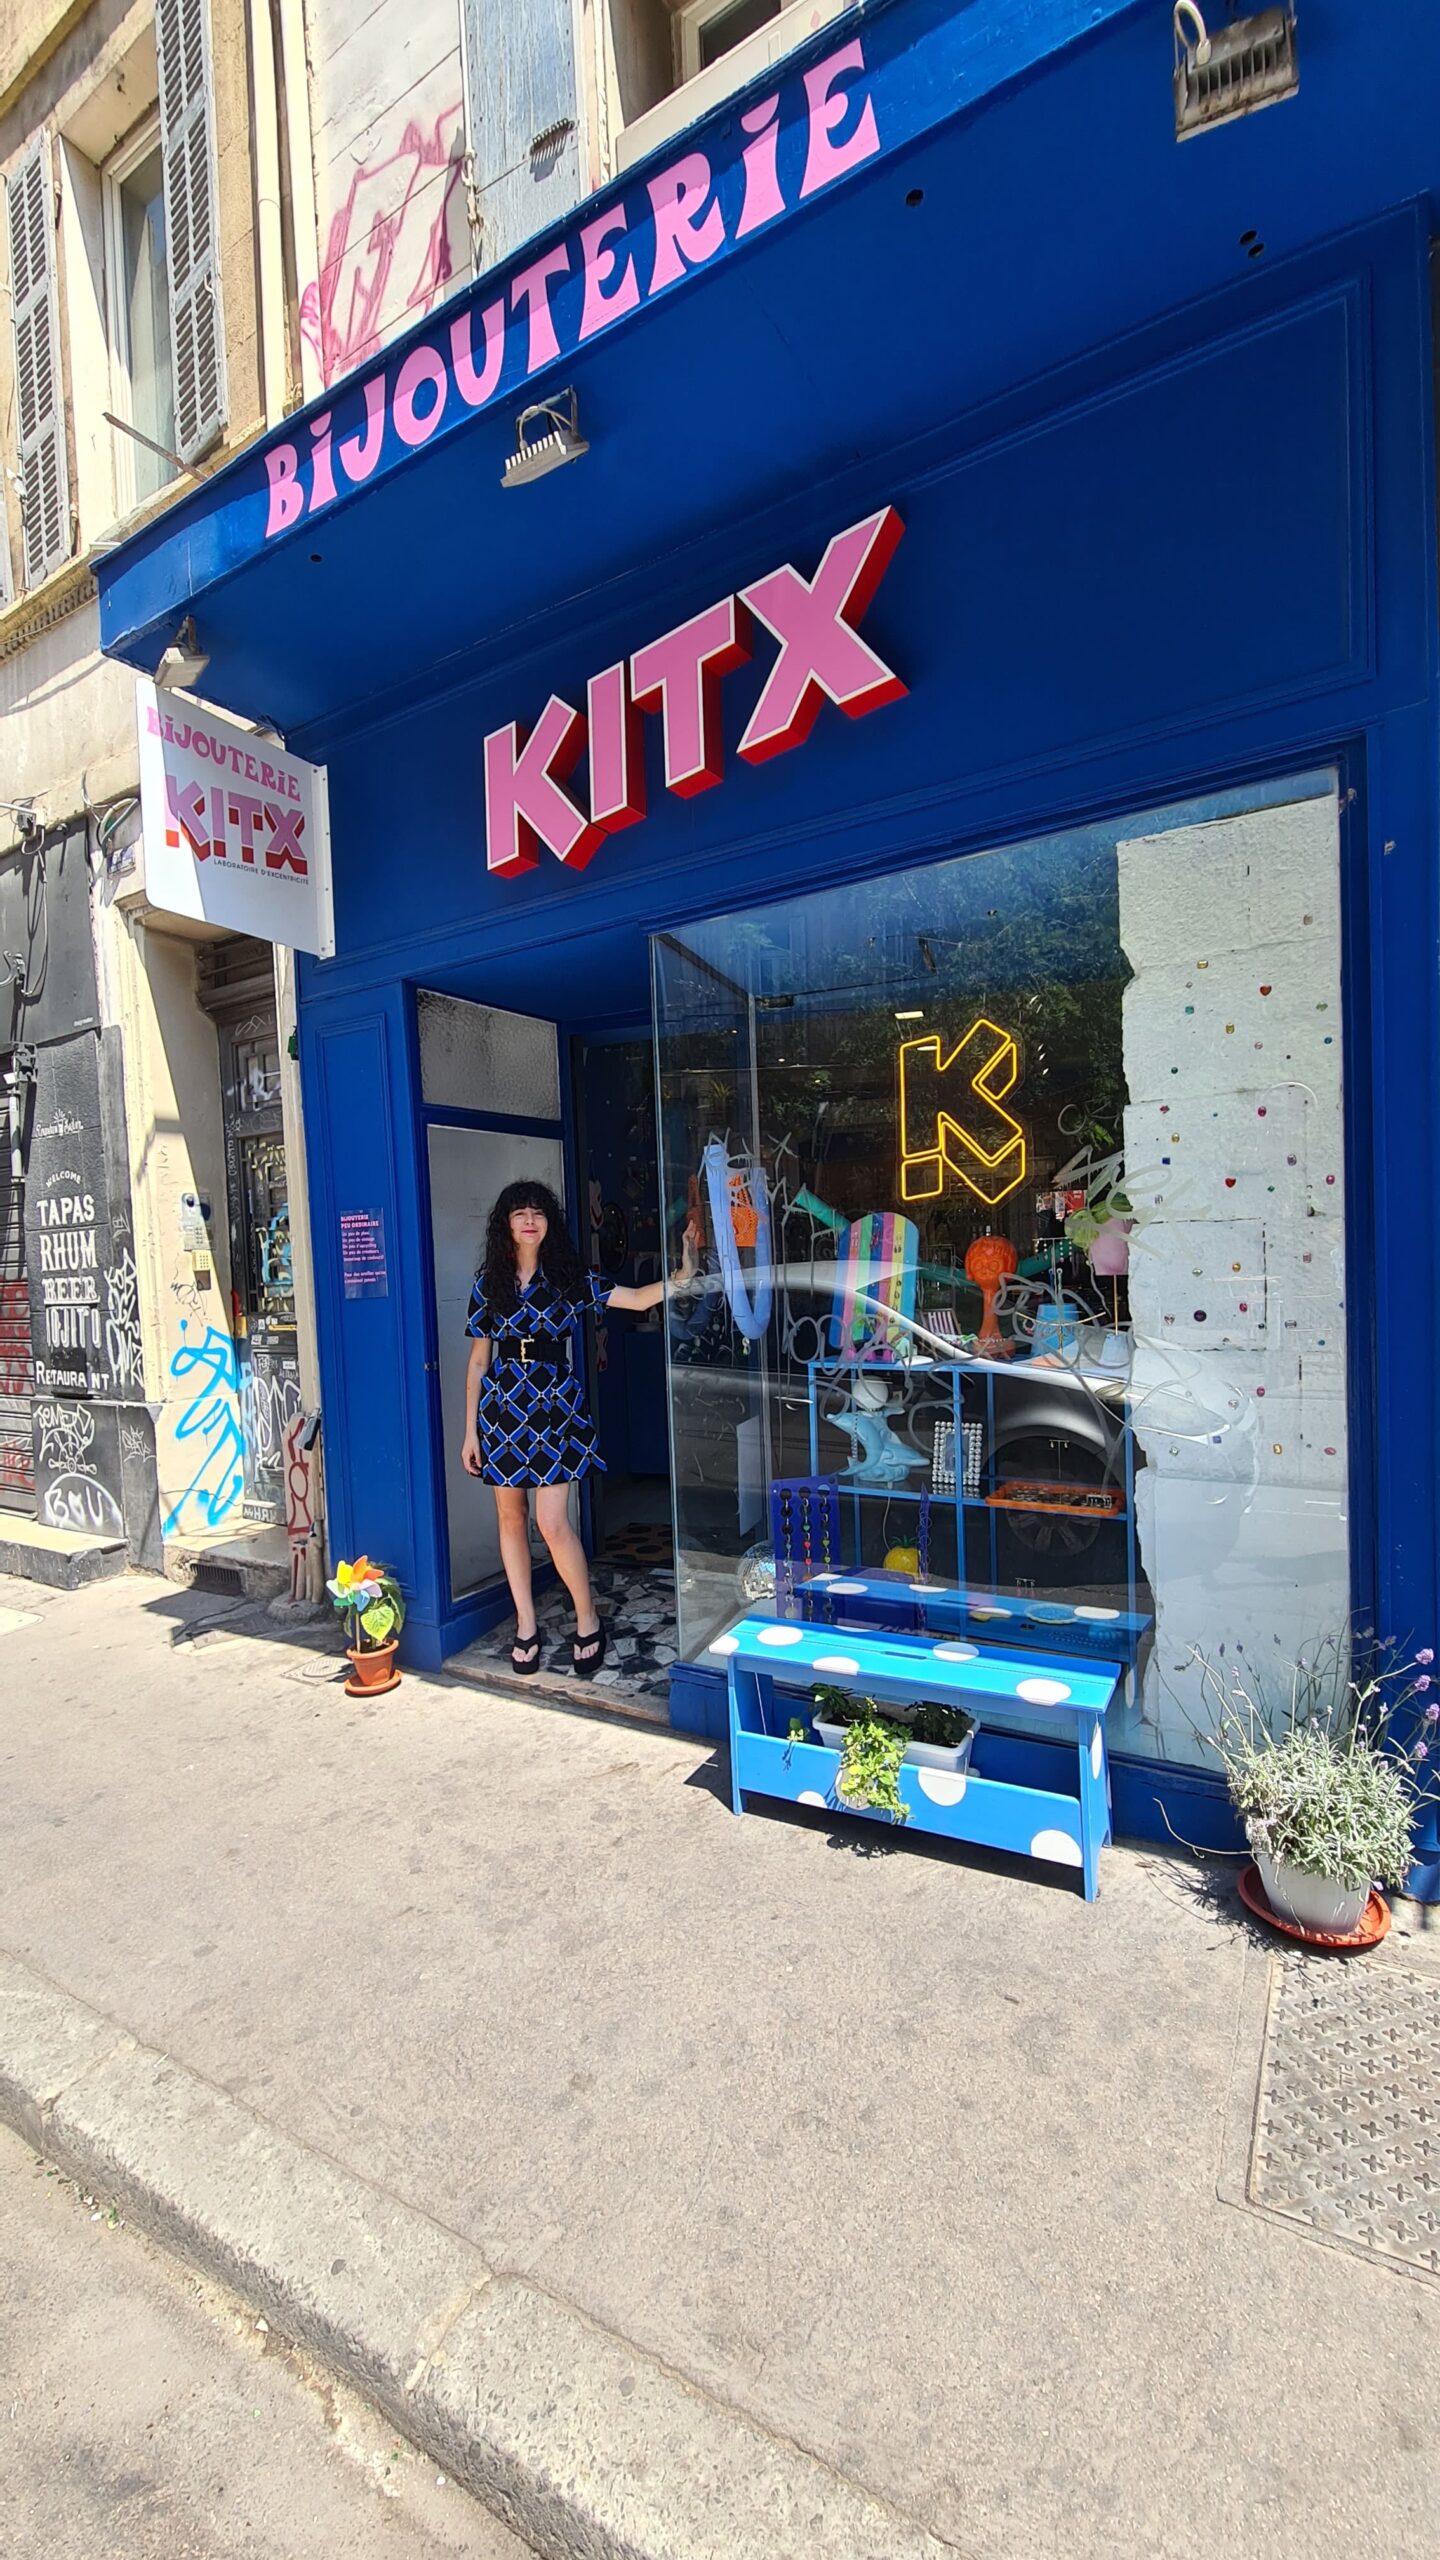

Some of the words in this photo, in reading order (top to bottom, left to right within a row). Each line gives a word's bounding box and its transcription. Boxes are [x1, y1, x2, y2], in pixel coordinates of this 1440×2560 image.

[483, 504, 911, 880] KITX
[164, 773, 308, 876] KITX
[899, 1018, 1026, 1205] K
[45, 1170, 82, 1188] WELCOME
[36, 1194, 96, 1227] TAPAS
[39, 1229, 99, 1272] RHUM
[42, 1276, 99, 1301] BEER
